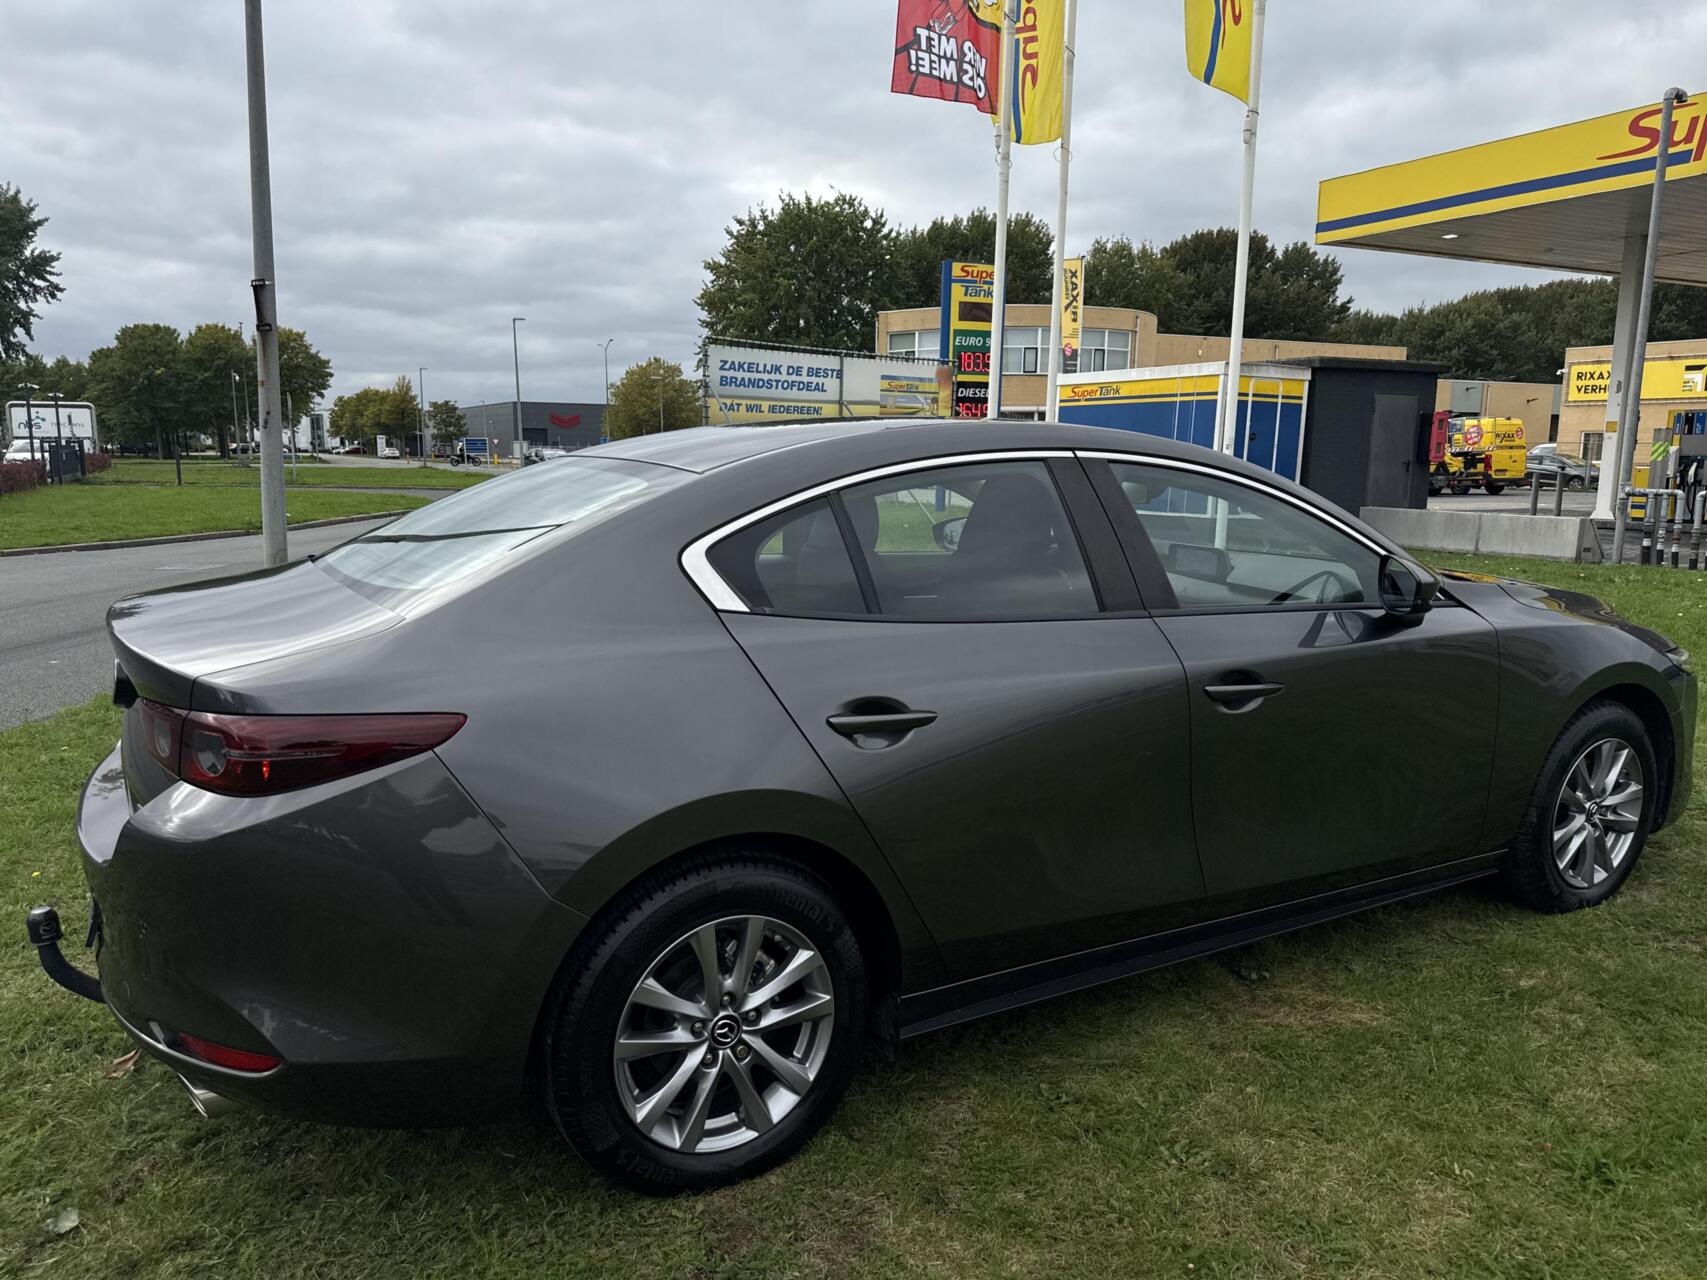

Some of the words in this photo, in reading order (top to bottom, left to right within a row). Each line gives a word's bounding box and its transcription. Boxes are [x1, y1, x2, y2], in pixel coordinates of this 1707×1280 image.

[952, 264, 994, 284] Supe
[960, 285, 994, 298] Tank
[955, 336, 983, 347] EURO
[985, 337, 991, 347] 9
[719, 359, 783, 376] ZAKELIJK
[786, 365, 804, 377] DE
[806, 366, 842, 379] BESTE
[719, 375, 828, 393] BRANDSTOFDEAL
[1576, 384, 1610, 395] VERH
[1067, 384, 1121, 402] SuperTank
[745, 403, 765, 413] WIL
[768, 404, 823, 416] IEDEREEN!
